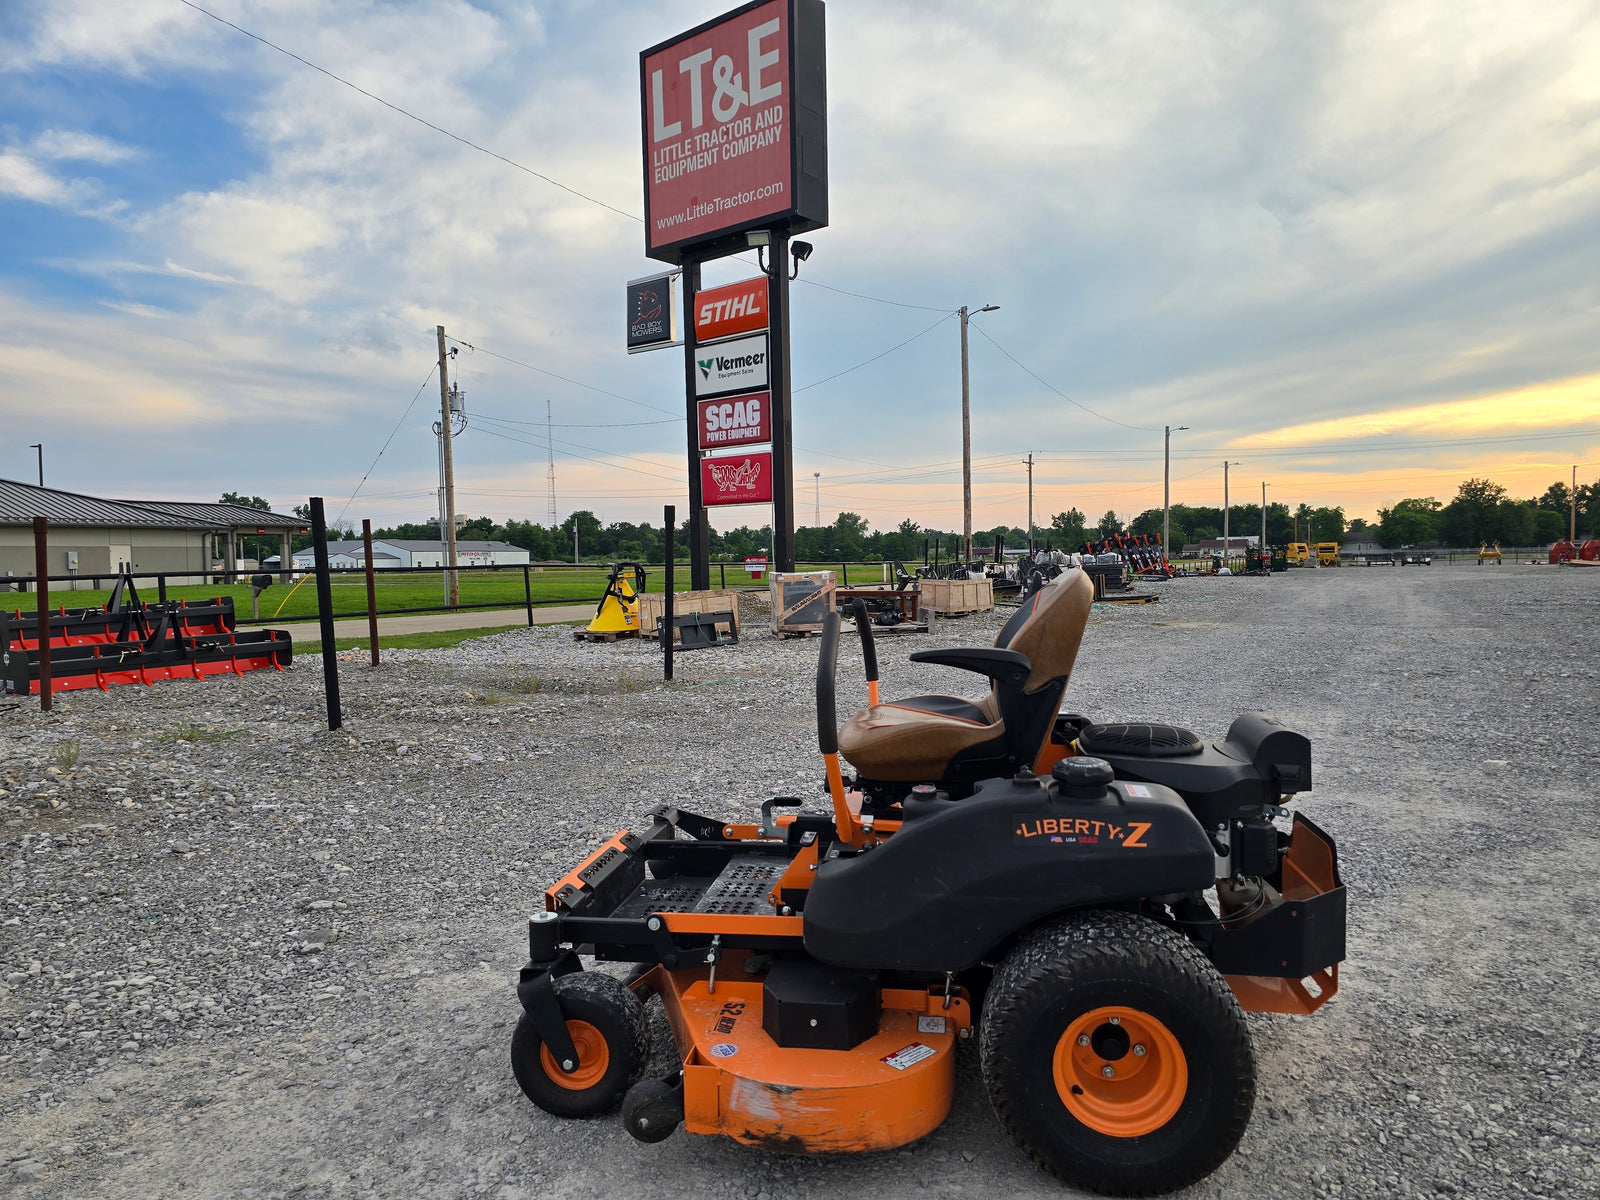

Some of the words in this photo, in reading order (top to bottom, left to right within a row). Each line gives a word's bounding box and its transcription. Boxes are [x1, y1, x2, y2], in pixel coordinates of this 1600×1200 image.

[652, 17, 782, 143] LT&E
[654, 138, 691, 167] LITTLE
[694, 117, 751, 154] TRACTOR
[755, 105, 783, 131] AND
[655, 149, 719, 184] EQUIPMENT
[722, 125, 782, 160] COMPANY
[657, 181, 783, 230] www.LittleTractor.com
[698, 293, 760, 326] STIHL
[631, 323, 646, 332] BAD
[648, 320, 662, 329] BOY
[631, 326, 663, 338] MOWERS
[716, 352, 765, 372] Vermeer
[718, 370, 742, 379] Equipment
[742, 368, 754, 376] Sales
[706, 399, 760, 431] SCAG
[706, 430, 727, 443] POWER
[728, 426, 761, 440] EQUIPMENT
[1021, 818, 1122, 840] LIBERTY
[1122, 822, 1152, 848] Z
